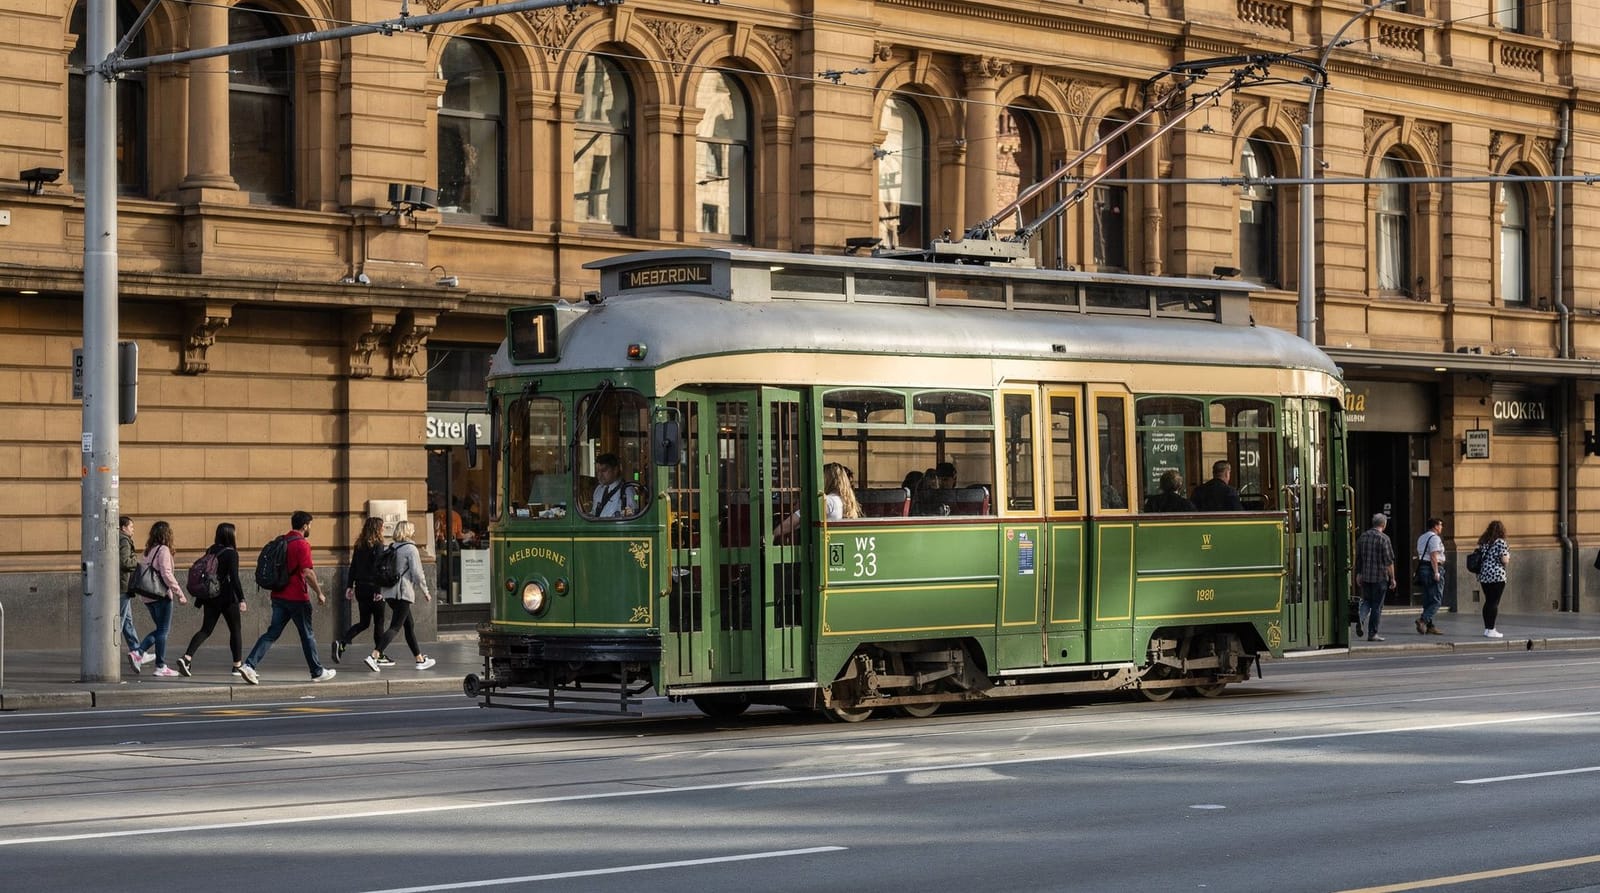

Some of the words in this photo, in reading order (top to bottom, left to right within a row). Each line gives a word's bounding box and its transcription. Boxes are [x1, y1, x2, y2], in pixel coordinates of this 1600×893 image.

[532, 314, 545, 353] 1
[426, 416, 482, 438] Stres
[855, 536, 876, 551] WS
[509, 547, 566, 567] MELBOURNE
[853, 552, 877, 577] 33
